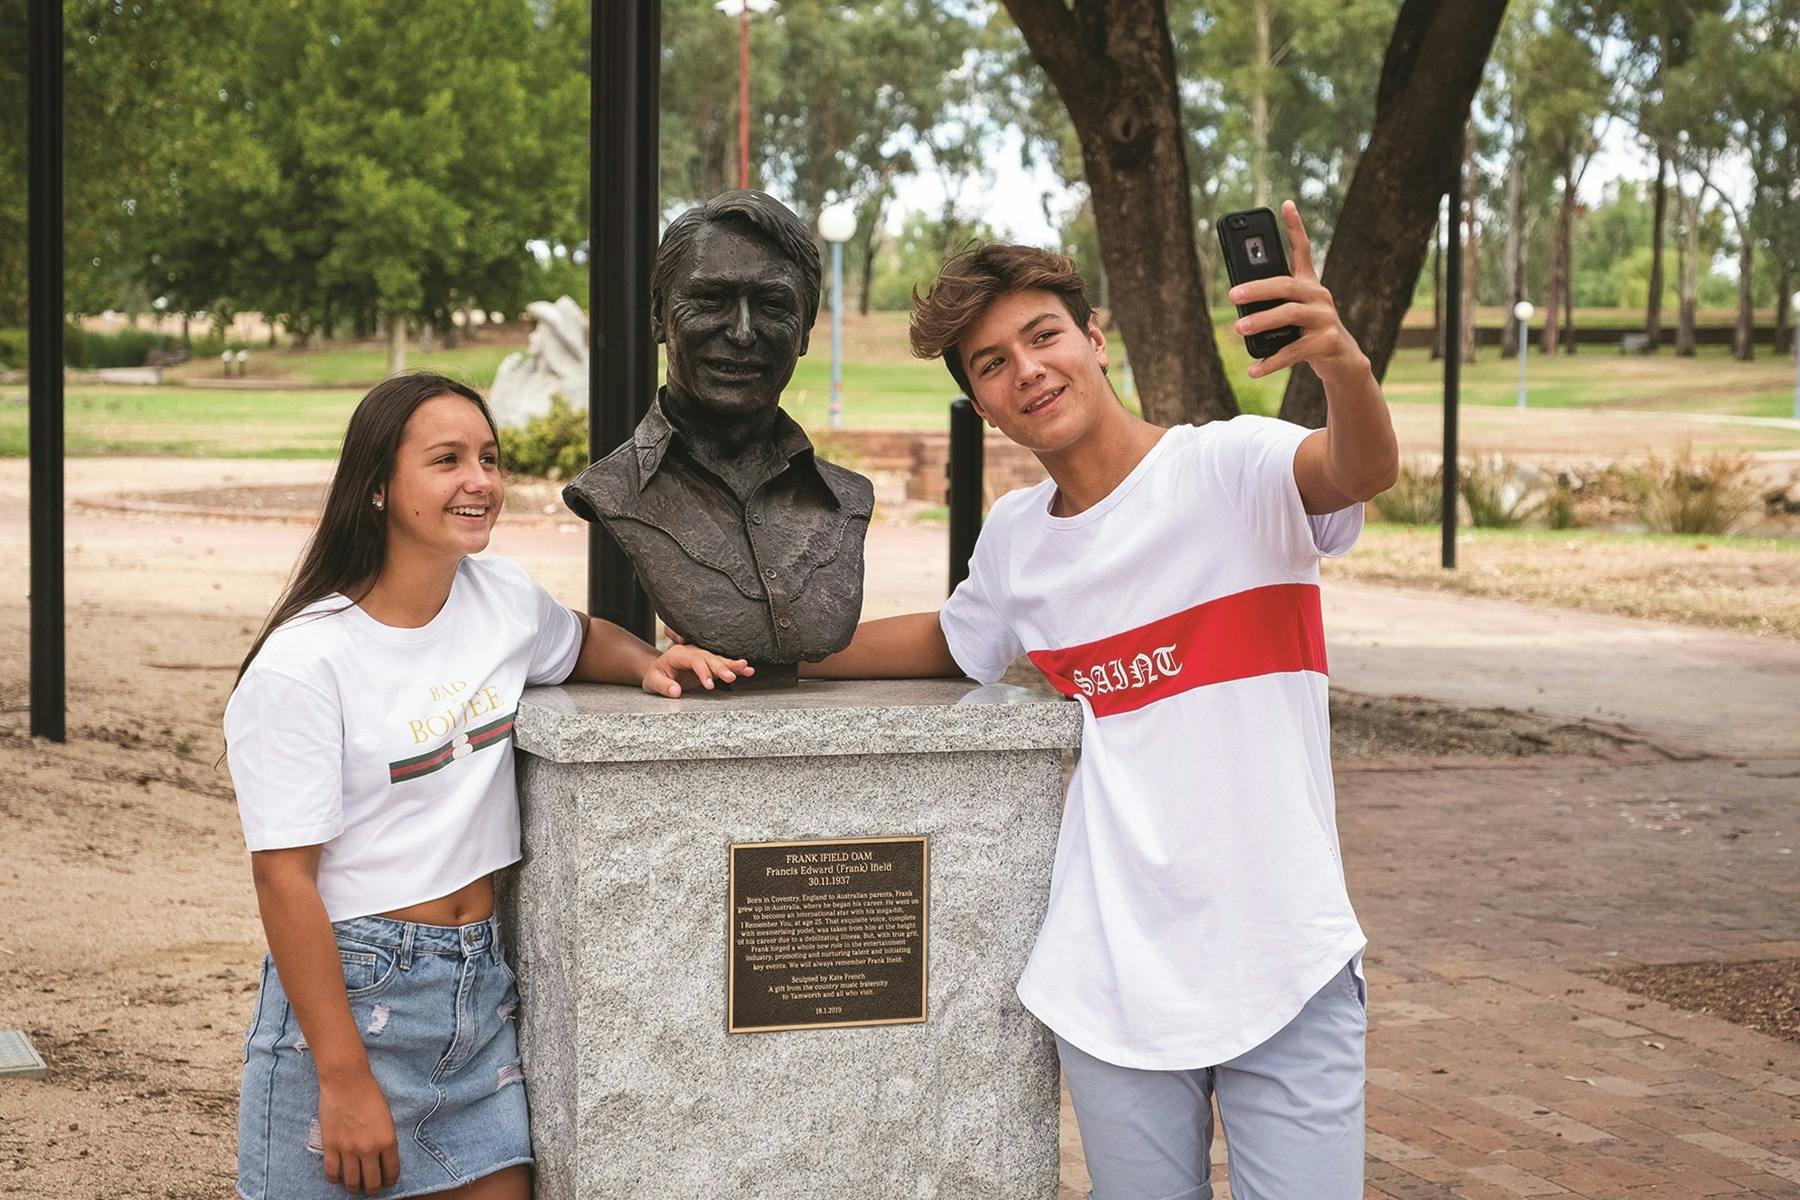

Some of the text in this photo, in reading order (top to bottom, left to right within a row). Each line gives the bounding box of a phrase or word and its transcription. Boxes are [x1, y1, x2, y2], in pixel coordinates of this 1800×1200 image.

[1073, 643, 1183, 697] SAINT
[428, 680, 468, 702] BAD
[786, 851, 873, 864] FRANK IFIELD OAM
[766, 862, 892, 876] Francis Edward (Frank) Ifield
[808, 876, 850, 887] 30.11.1937
[802, 894, 827, 902] England
[832, 901, 851, 909] began
[745, 921, 778, 929] Remember
[802, 920, 813, 928] age
[825, 917, 840, 925] That
[841, 916, 868, 924] exquisite
[888, 914, 916, 922] complete
[741, 929, 755, 937] with
[896, 922, 916, 930] height
[804, 934, 840, 942] debilitating
[770, 945, 790, 953] forged
[774, 952, 807, 961] promoting
[752, 964, 764, 972] key
[812, 960, 833, 968] always
[791, 975, 819, 984] Sculpted
[819, 975, 829, 983] by
[768, 985, 774, 993] A
[774, 985, 786, 994] gift
[814, 983, 839, 991] country
[859, 980, 888, 988] fraternity
